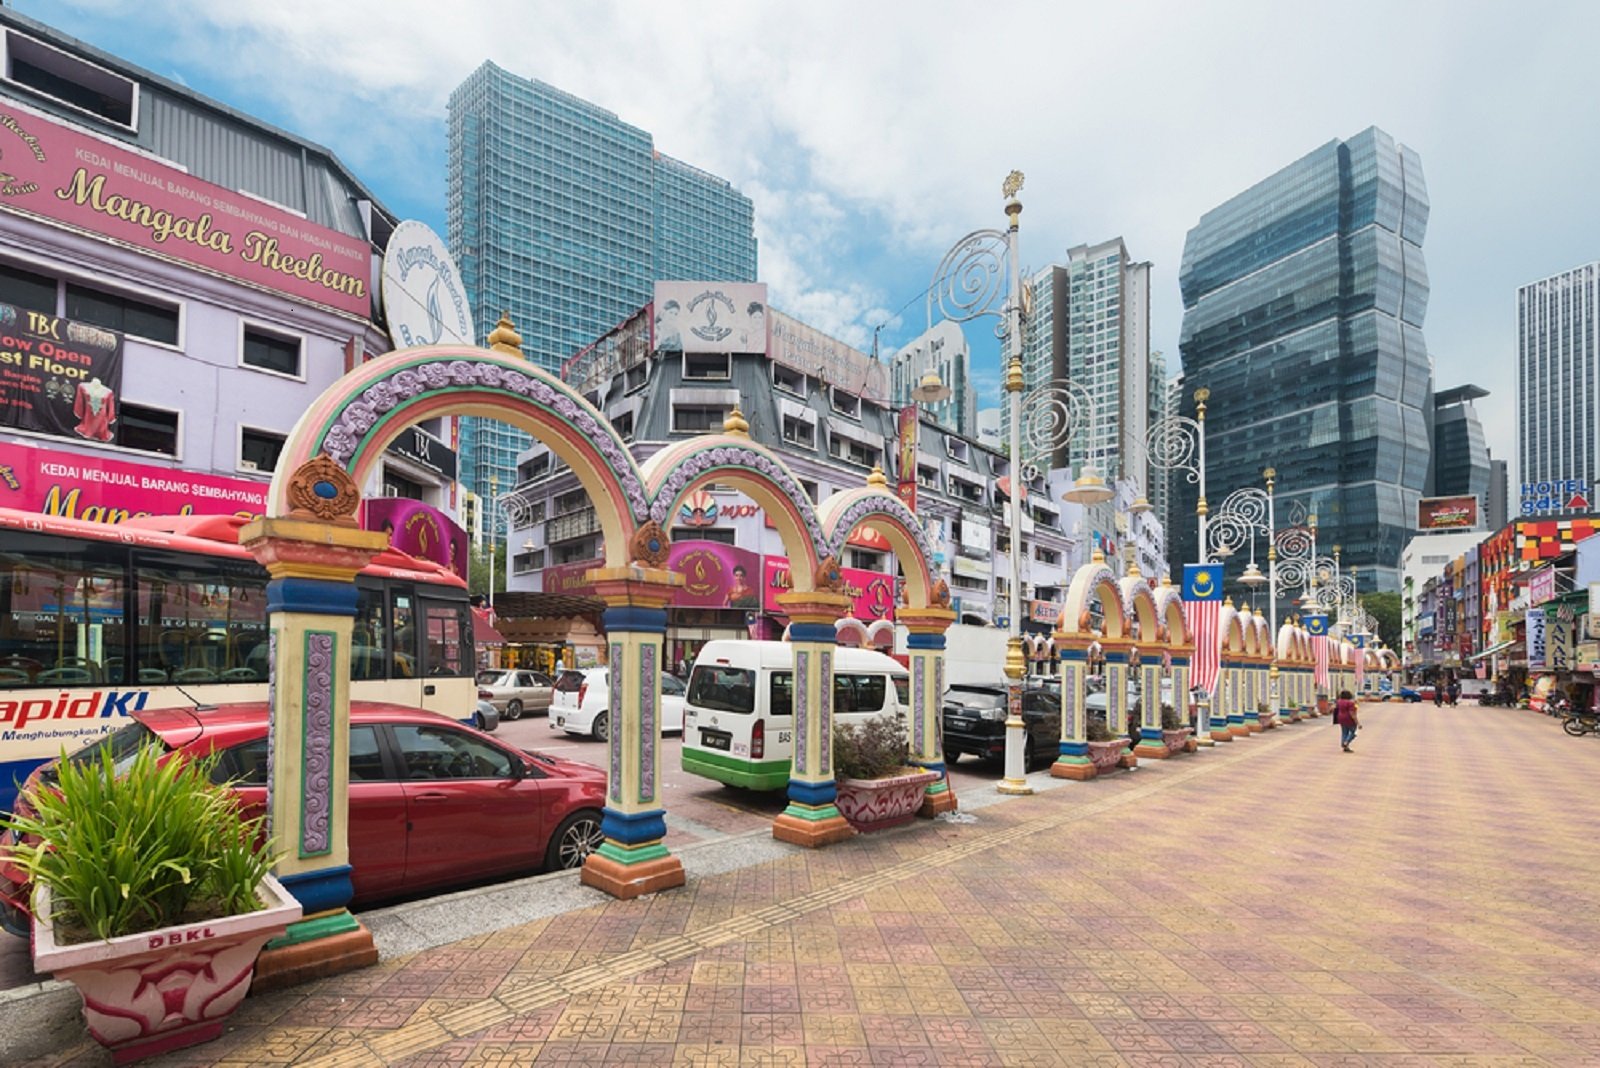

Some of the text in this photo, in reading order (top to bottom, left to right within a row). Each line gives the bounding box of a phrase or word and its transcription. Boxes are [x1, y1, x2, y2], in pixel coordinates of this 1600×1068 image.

[75, 147, 111, 170] KEDAI
[113, 161, 165, 191] MENJUAL
[167, 181, 211, 207] BARANG
[212, 199, 278, 231] SEMBAHYANG
[279, 223, 298, 239] DAN
[54, 167, 366, 298] Mangala Theebam
[0, 335, 92, 366] ow Open
[0, 351, 89, 379] st Floor
[41, 462, 79, 479] KEDAI
[82, 467, 139, 488] MENJUAL
[141, 477, 189, 494] BARANG
[191, 483, 262, 505] SEMBAHYANG
[1521, 480, 1589, 495] HOTEL
[1521, 496, 1562, 514] gds
[0, 691, 149, 729] apidK
[2, 726, 98, 741] Menghubungkan
[149, 928, 215, 949] DBKL
